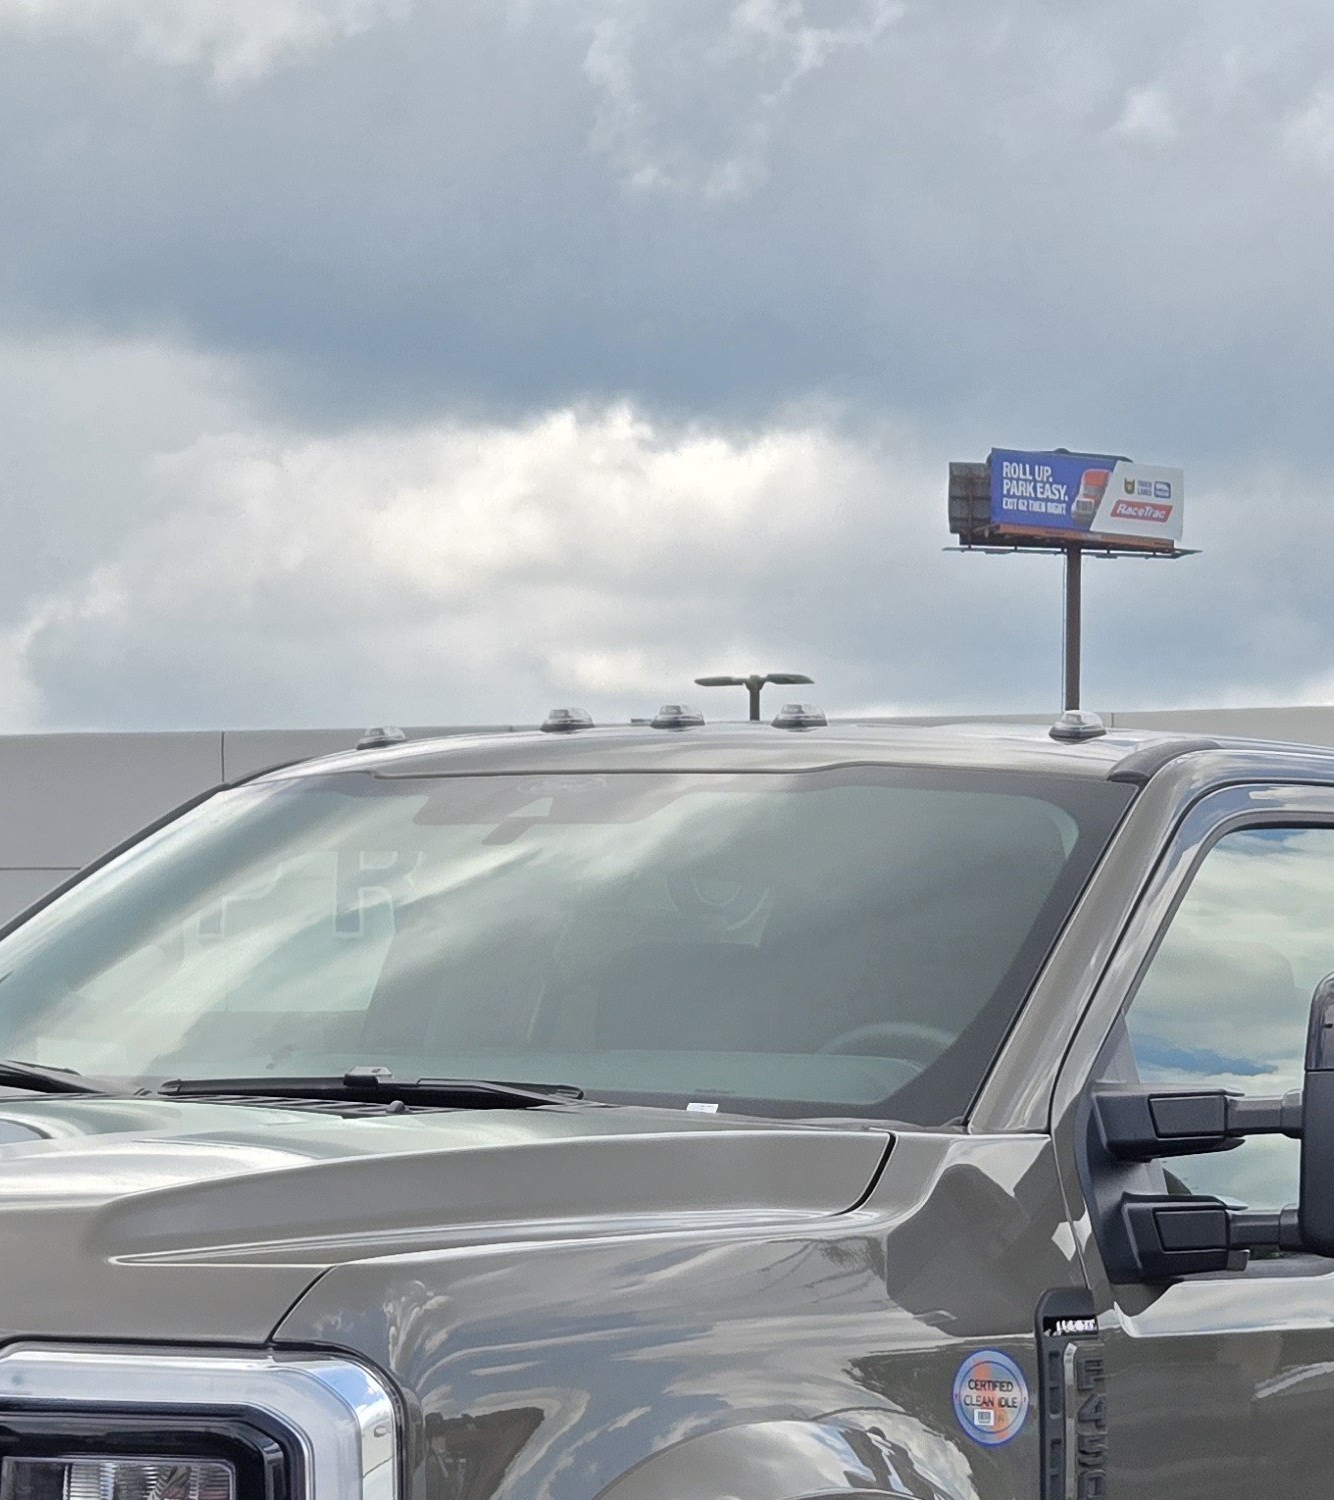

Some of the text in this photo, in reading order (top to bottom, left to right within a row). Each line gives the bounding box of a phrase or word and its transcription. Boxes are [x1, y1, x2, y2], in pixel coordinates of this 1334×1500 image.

[1002, 461, 1053, 482] ROLL UP.
[1002, 479, 1069, 501] PARK EASY.
[1116, 503, 1166, 519] RaceTrac
[968, 1378, 1014, 1393] CERTIFIED
[964, 1394, 1018, 1409] CLEAN IDLE
